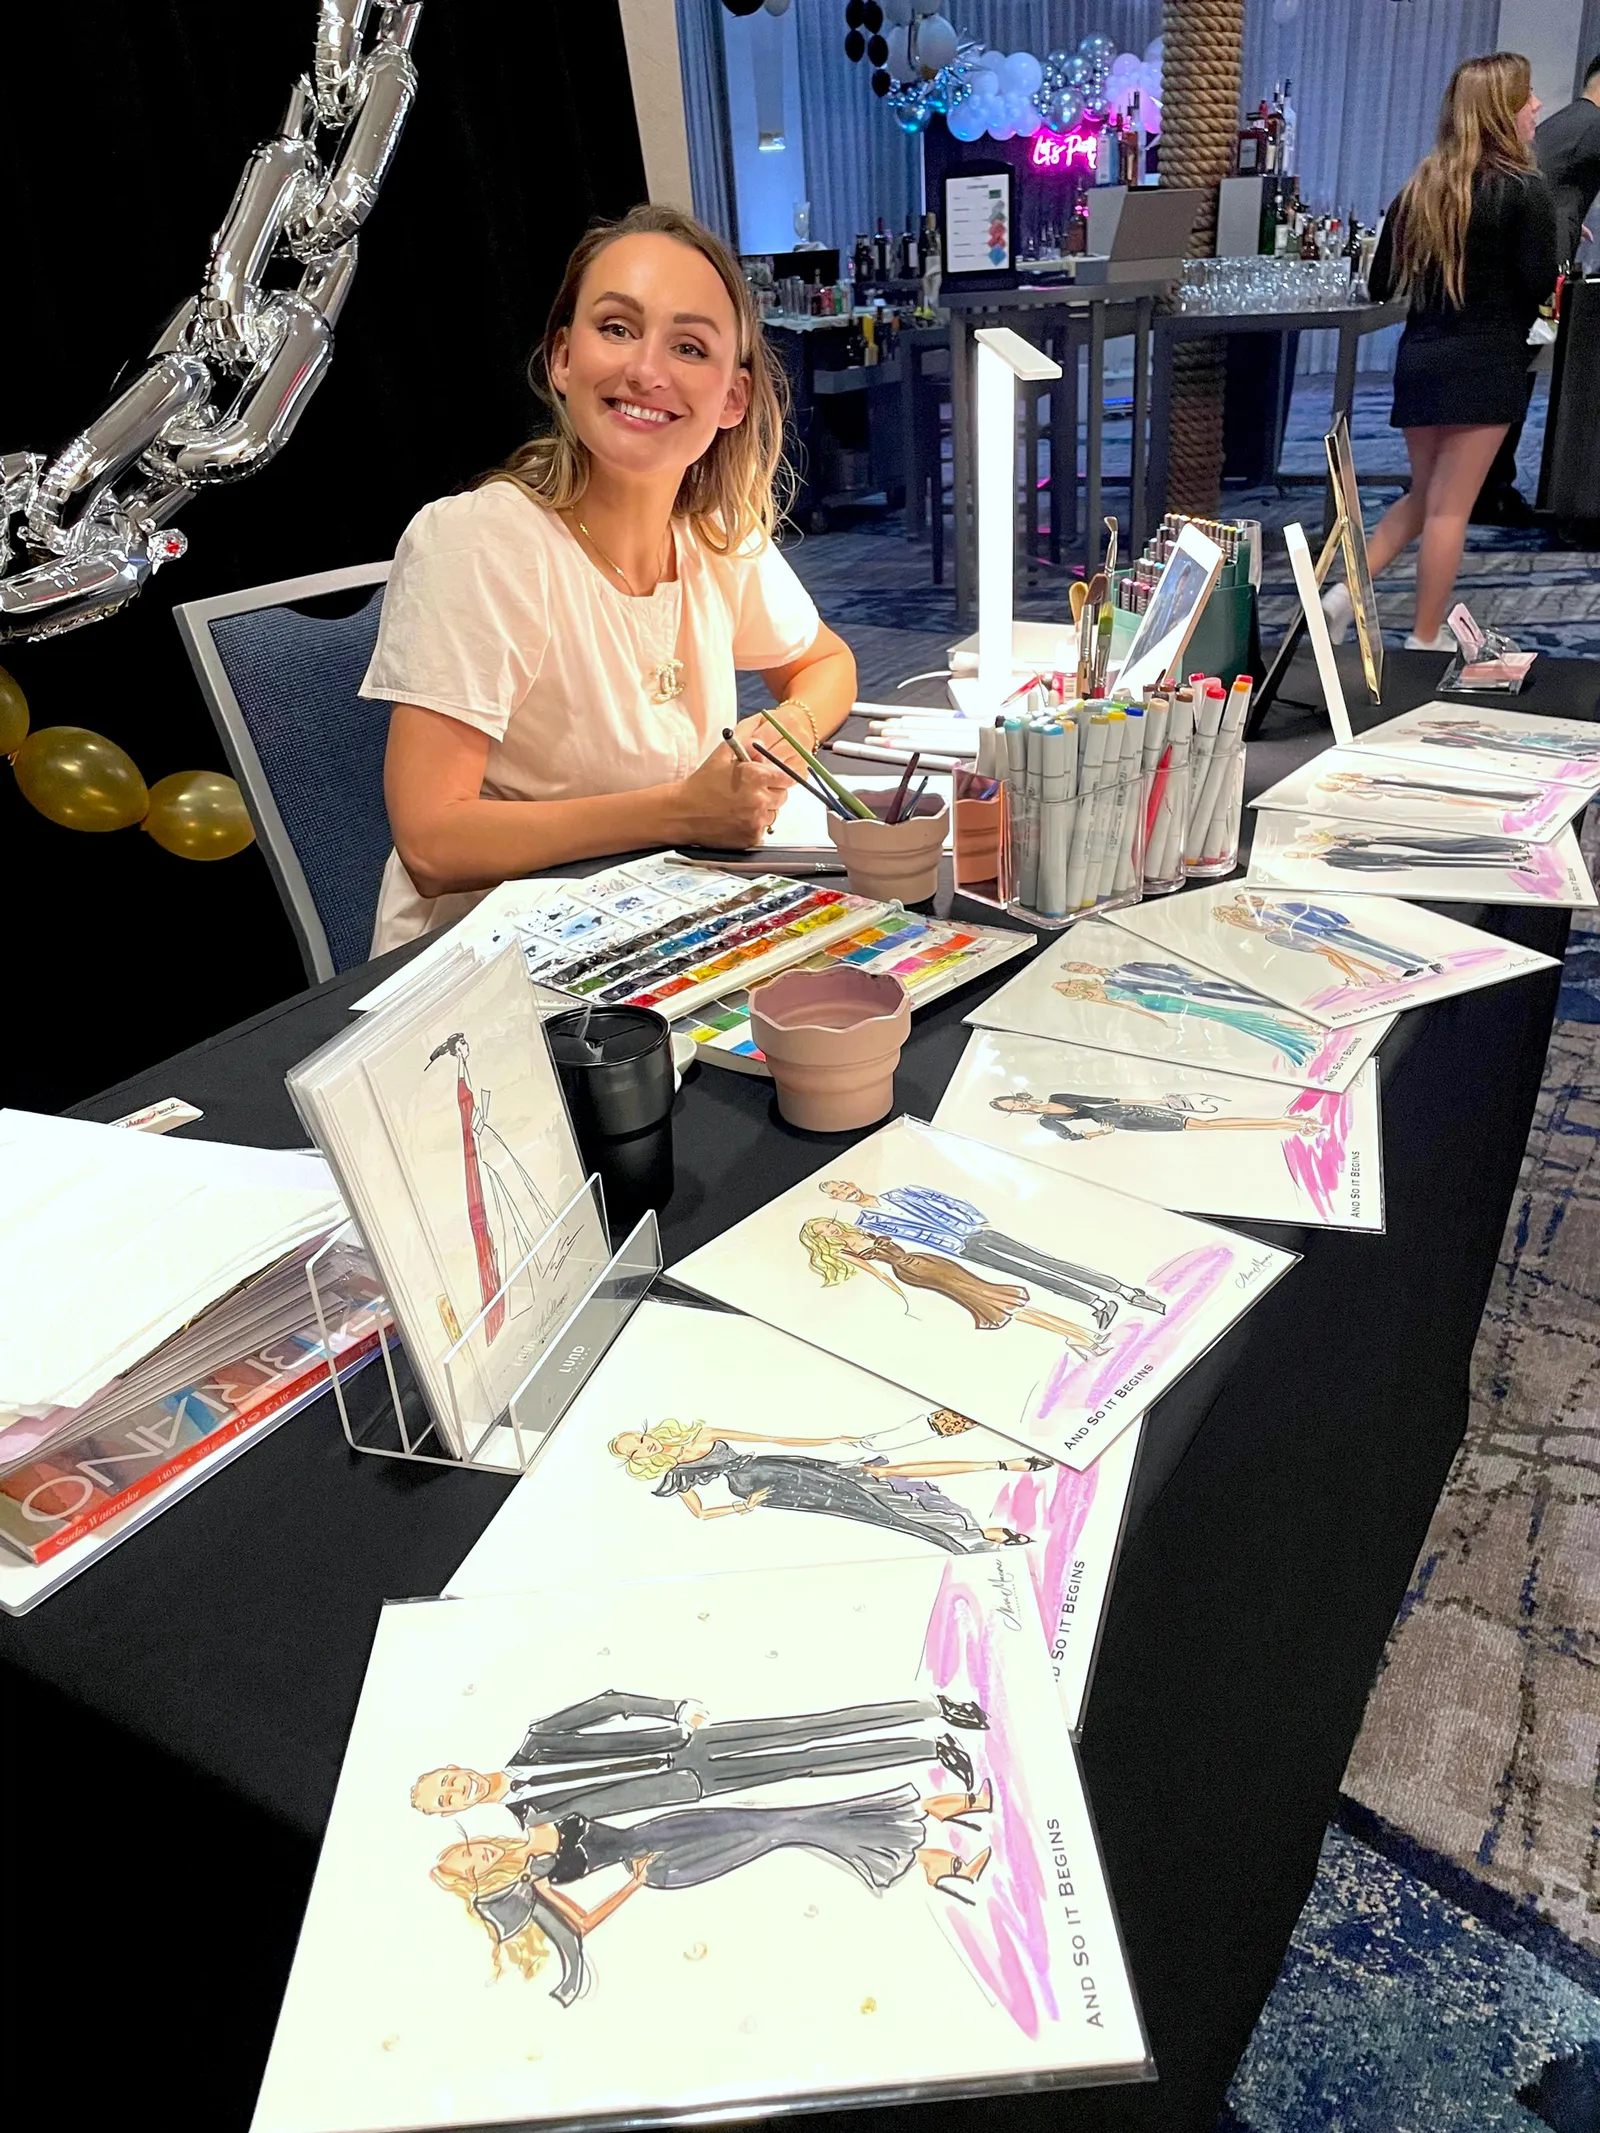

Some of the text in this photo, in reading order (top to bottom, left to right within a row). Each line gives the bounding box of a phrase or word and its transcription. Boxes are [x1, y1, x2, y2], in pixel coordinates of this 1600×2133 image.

[56, 1525, 88, 1546] Studio
[88, 1488, 141, 1527] Watercolor
[233, 1418, 249, 1434] 12
